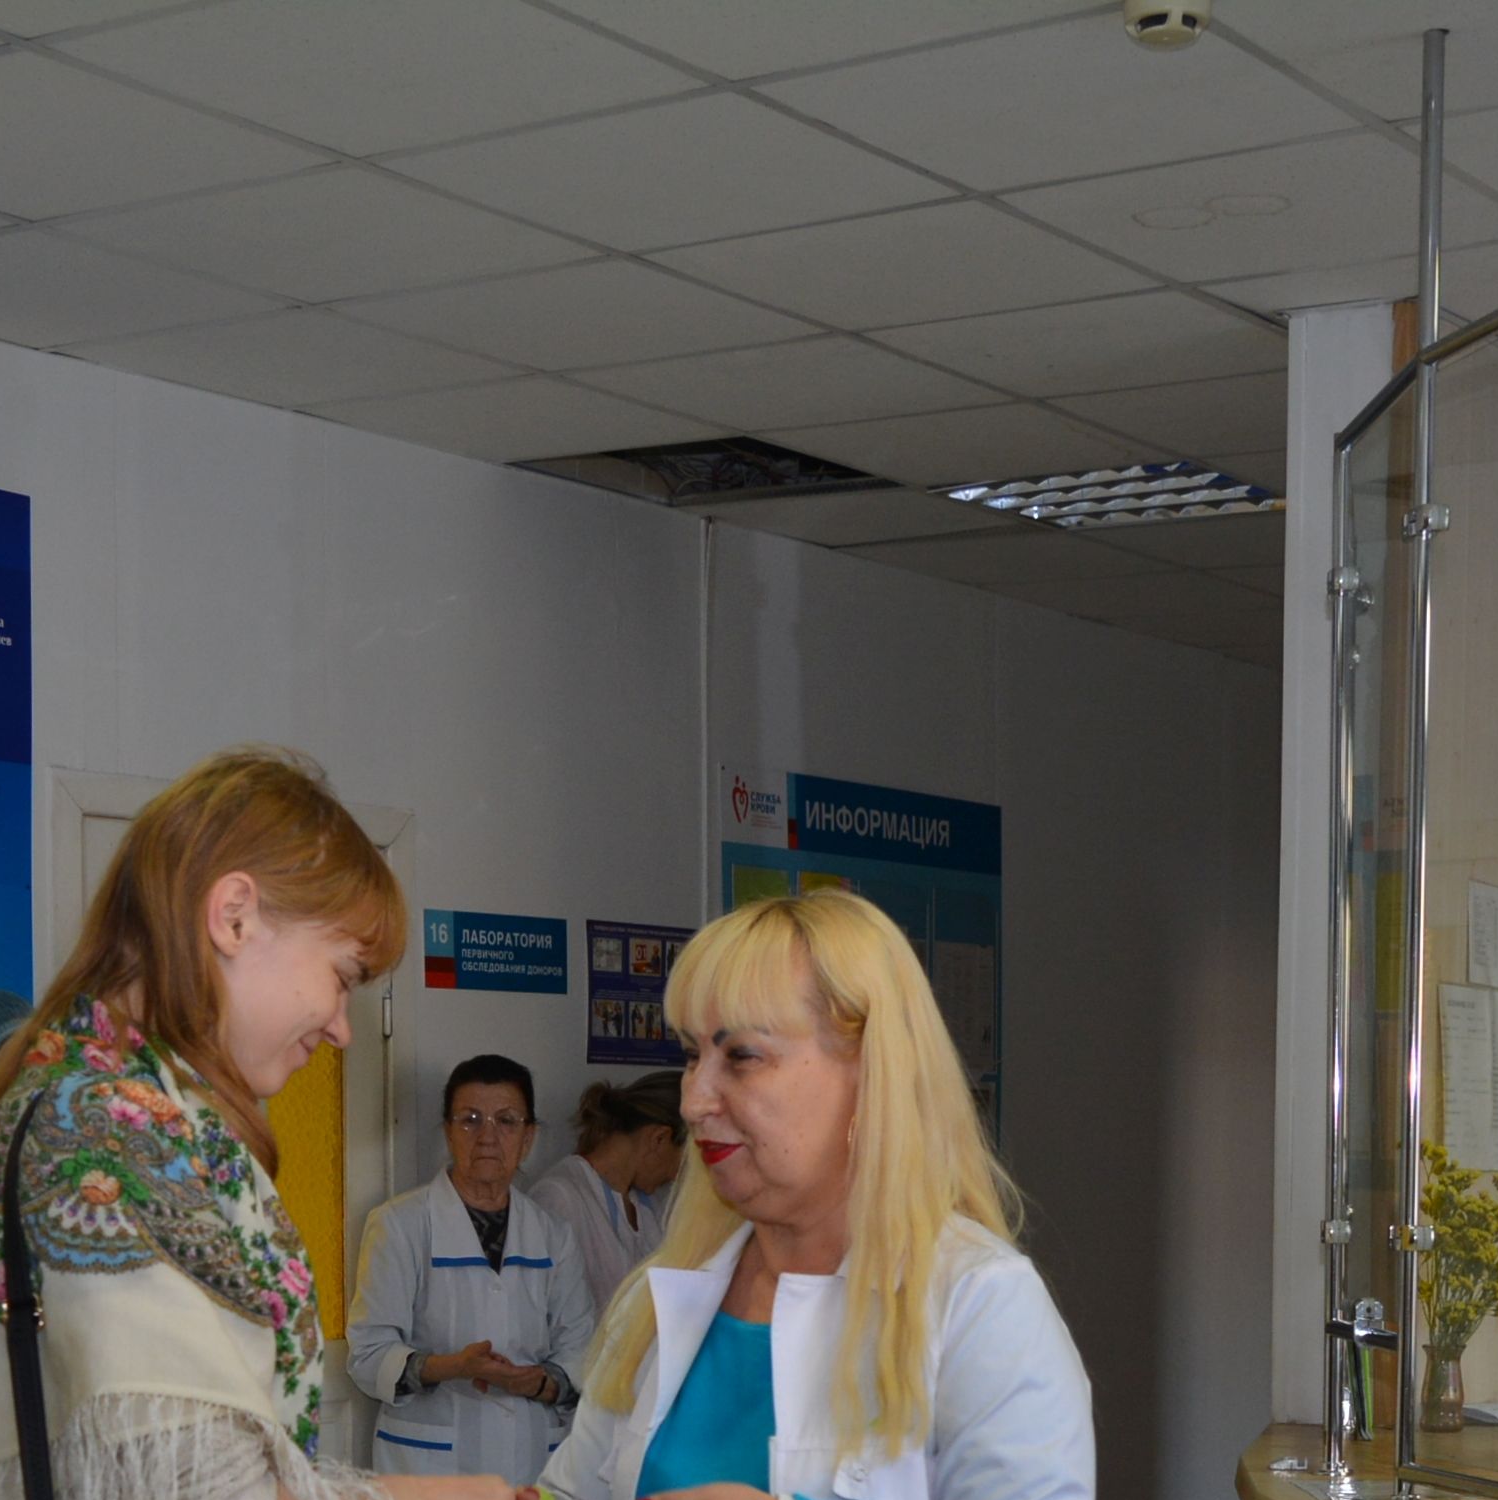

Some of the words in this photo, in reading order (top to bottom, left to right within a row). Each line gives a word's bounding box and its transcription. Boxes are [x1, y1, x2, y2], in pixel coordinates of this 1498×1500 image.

[805, 800, 950, 850] ИНФОРМАЦИЯ
[430, 923, 448, 943] 16
[461, 929, 553, 949] ЛАБОРАТОРИЯ
[461, 948, 514, 960] ПЕРВИЧНОГО
[462, 962, 526, 975] ОБСЛЕДОВАНИЯ
[527, 966, 563, 977] ДОНОРОВ
